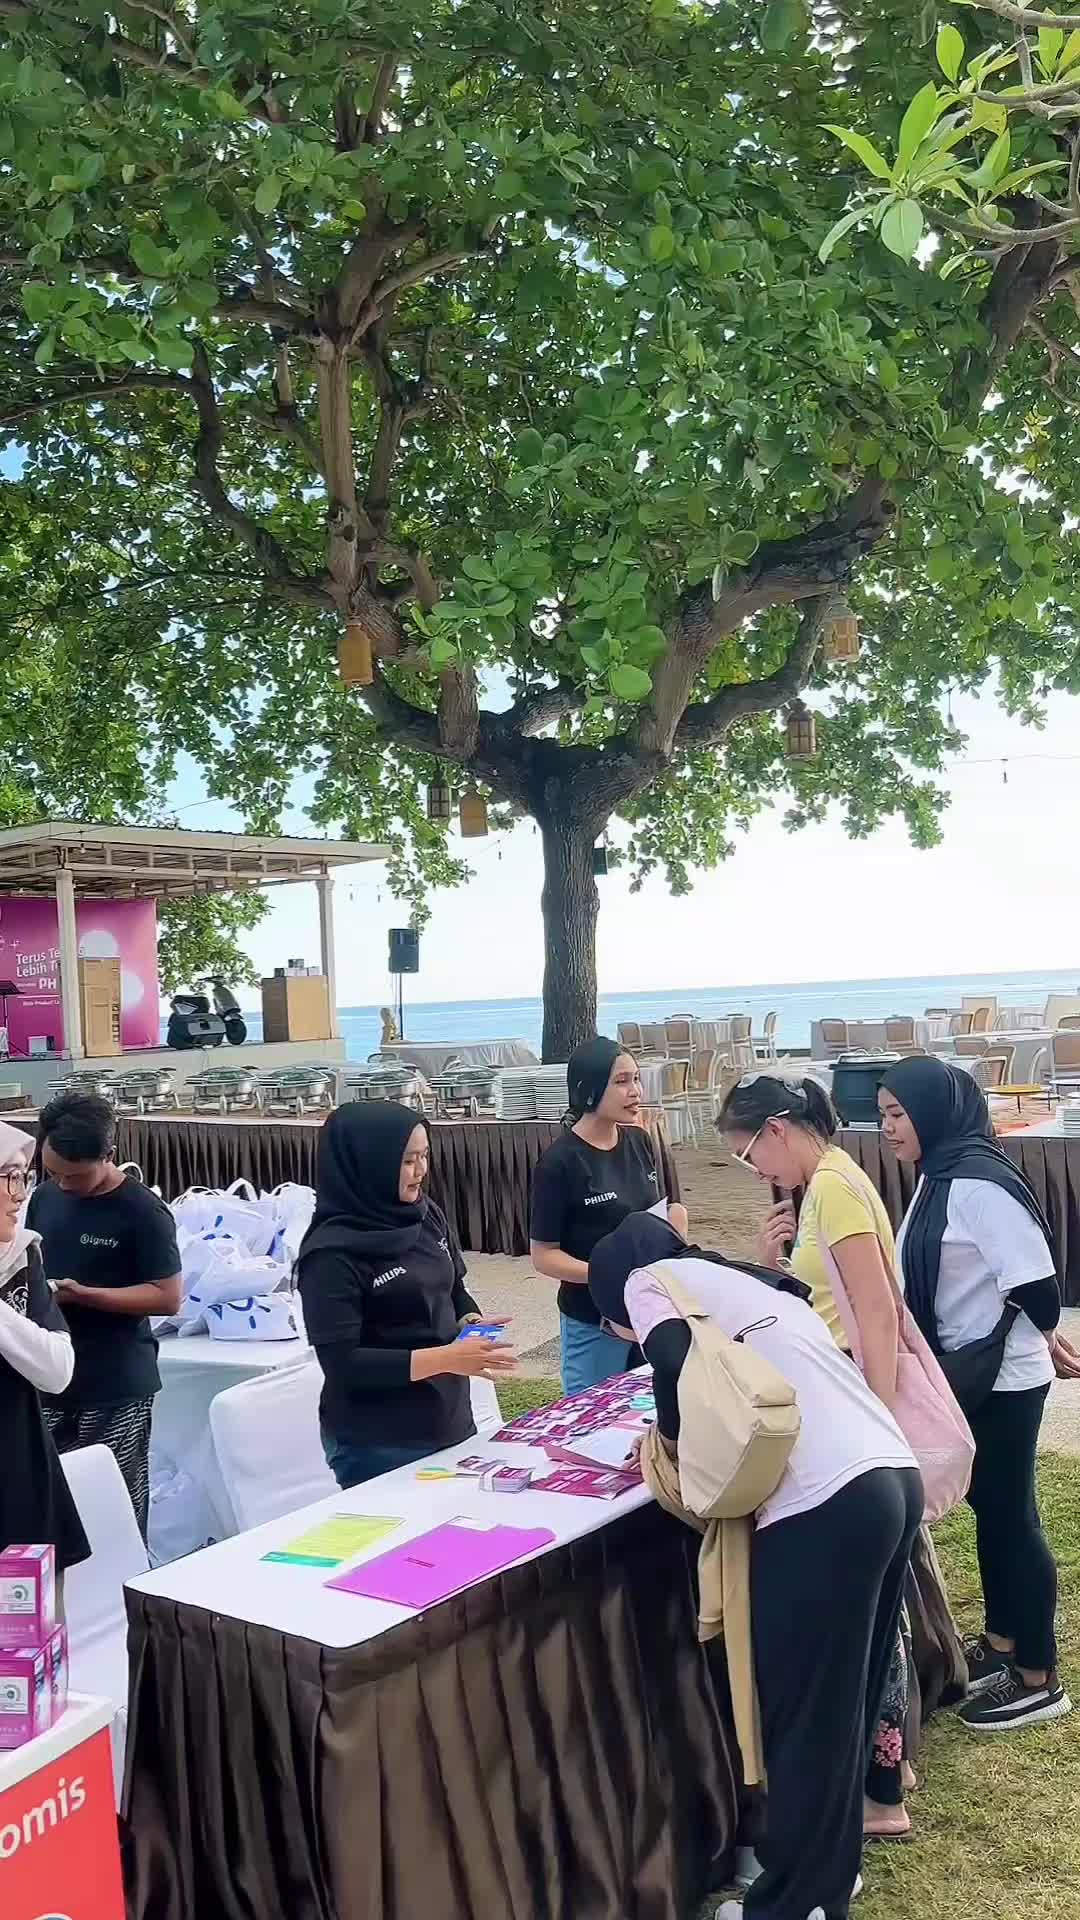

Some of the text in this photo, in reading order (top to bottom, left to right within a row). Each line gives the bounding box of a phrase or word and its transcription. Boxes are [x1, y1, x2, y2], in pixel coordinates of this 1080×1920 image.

[16, 952, 46, 965] Terus
[16, 962, 47, 977] Lebih
[584, 1191, 618, 1206] PHILIPS
